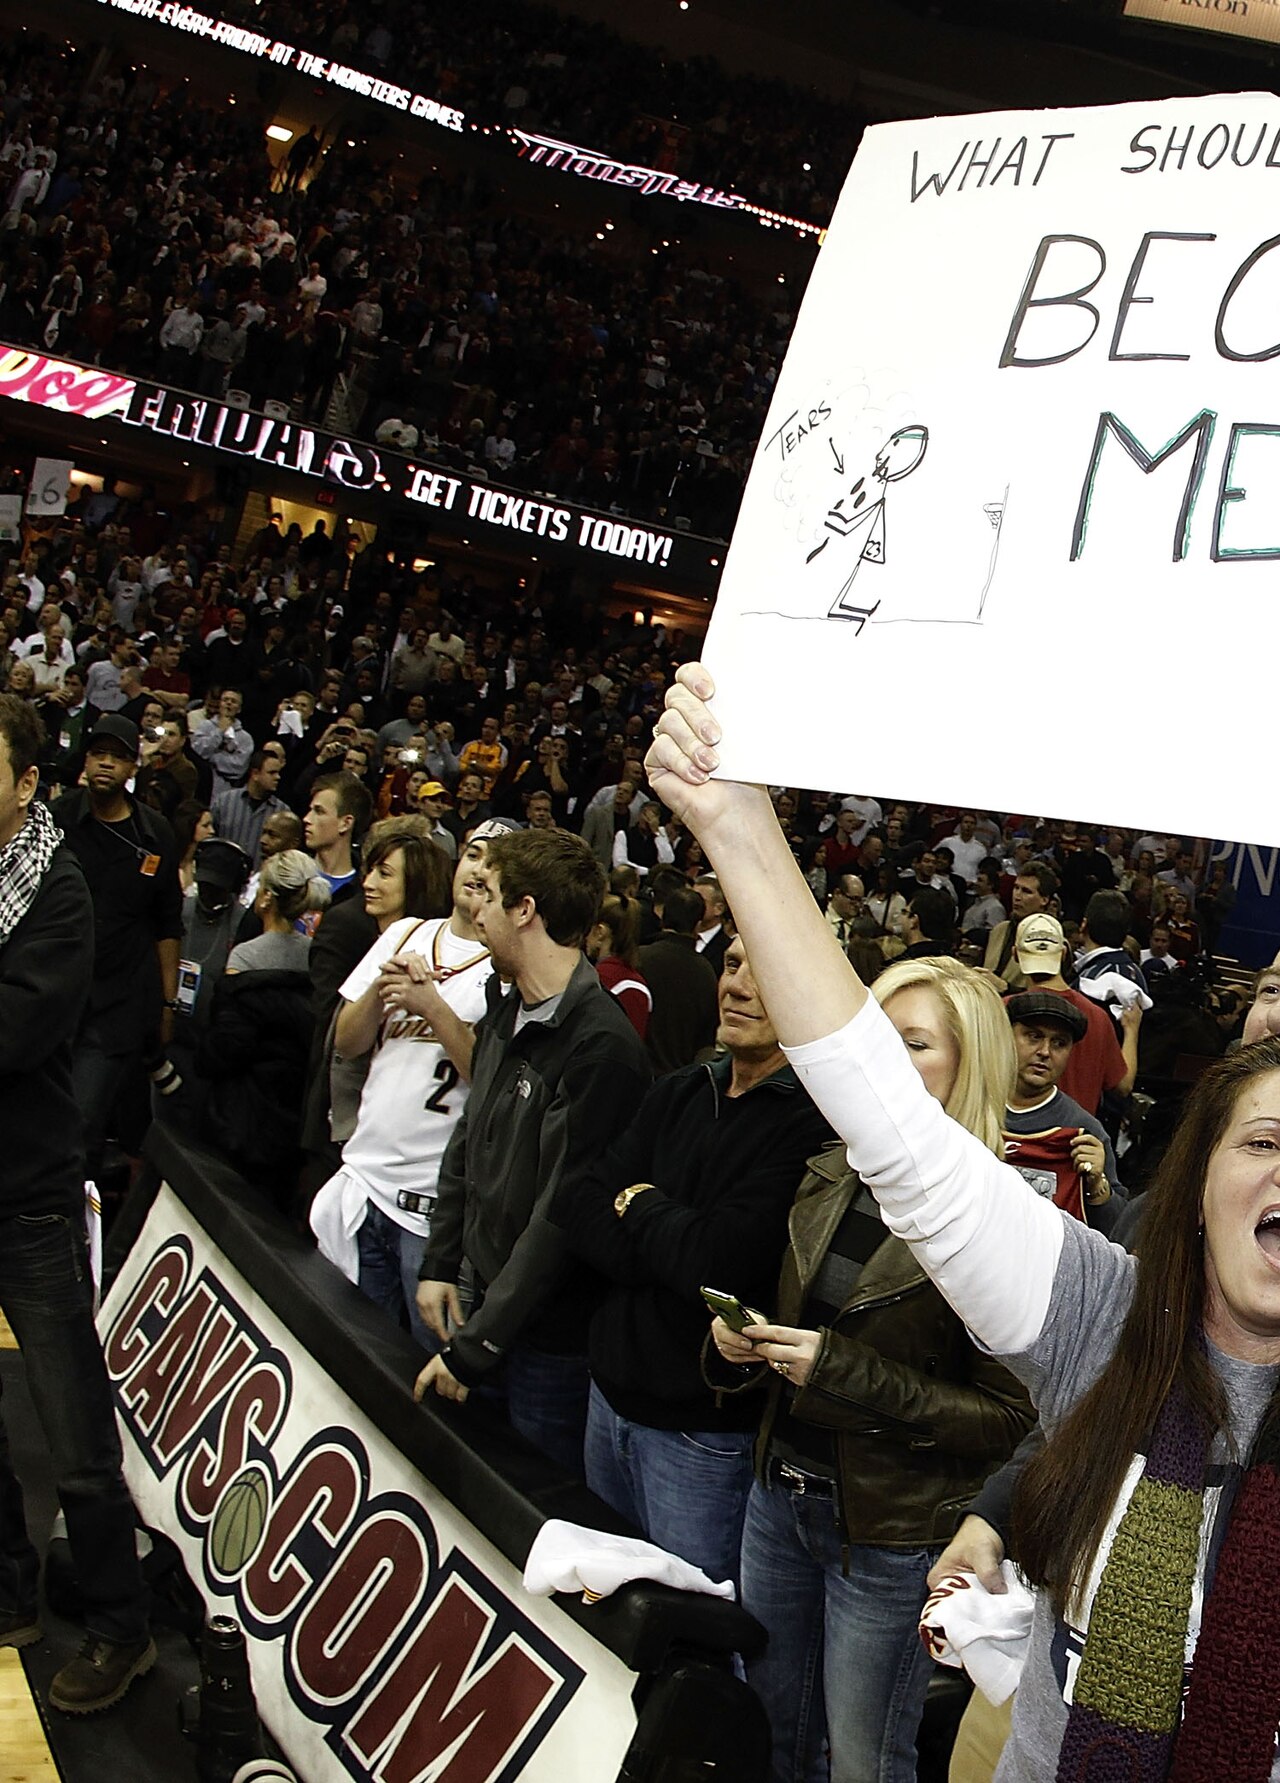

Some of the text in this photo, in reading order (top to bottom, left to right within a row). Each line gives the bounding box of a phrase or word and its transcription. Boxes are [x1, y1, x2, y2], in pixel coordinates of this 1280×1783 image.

[270, 41, 296, 66] AT
[297, 50, 329, 79] THE
[327, 62, 411, 110] MONSTERS
[911, 133, 1075, 202] WHAT
[764, 400, 832, 462] TEARS
[42, 477, 60, 505] 6
[410, 469, 674, 568] GET TICKETS TODAY!
